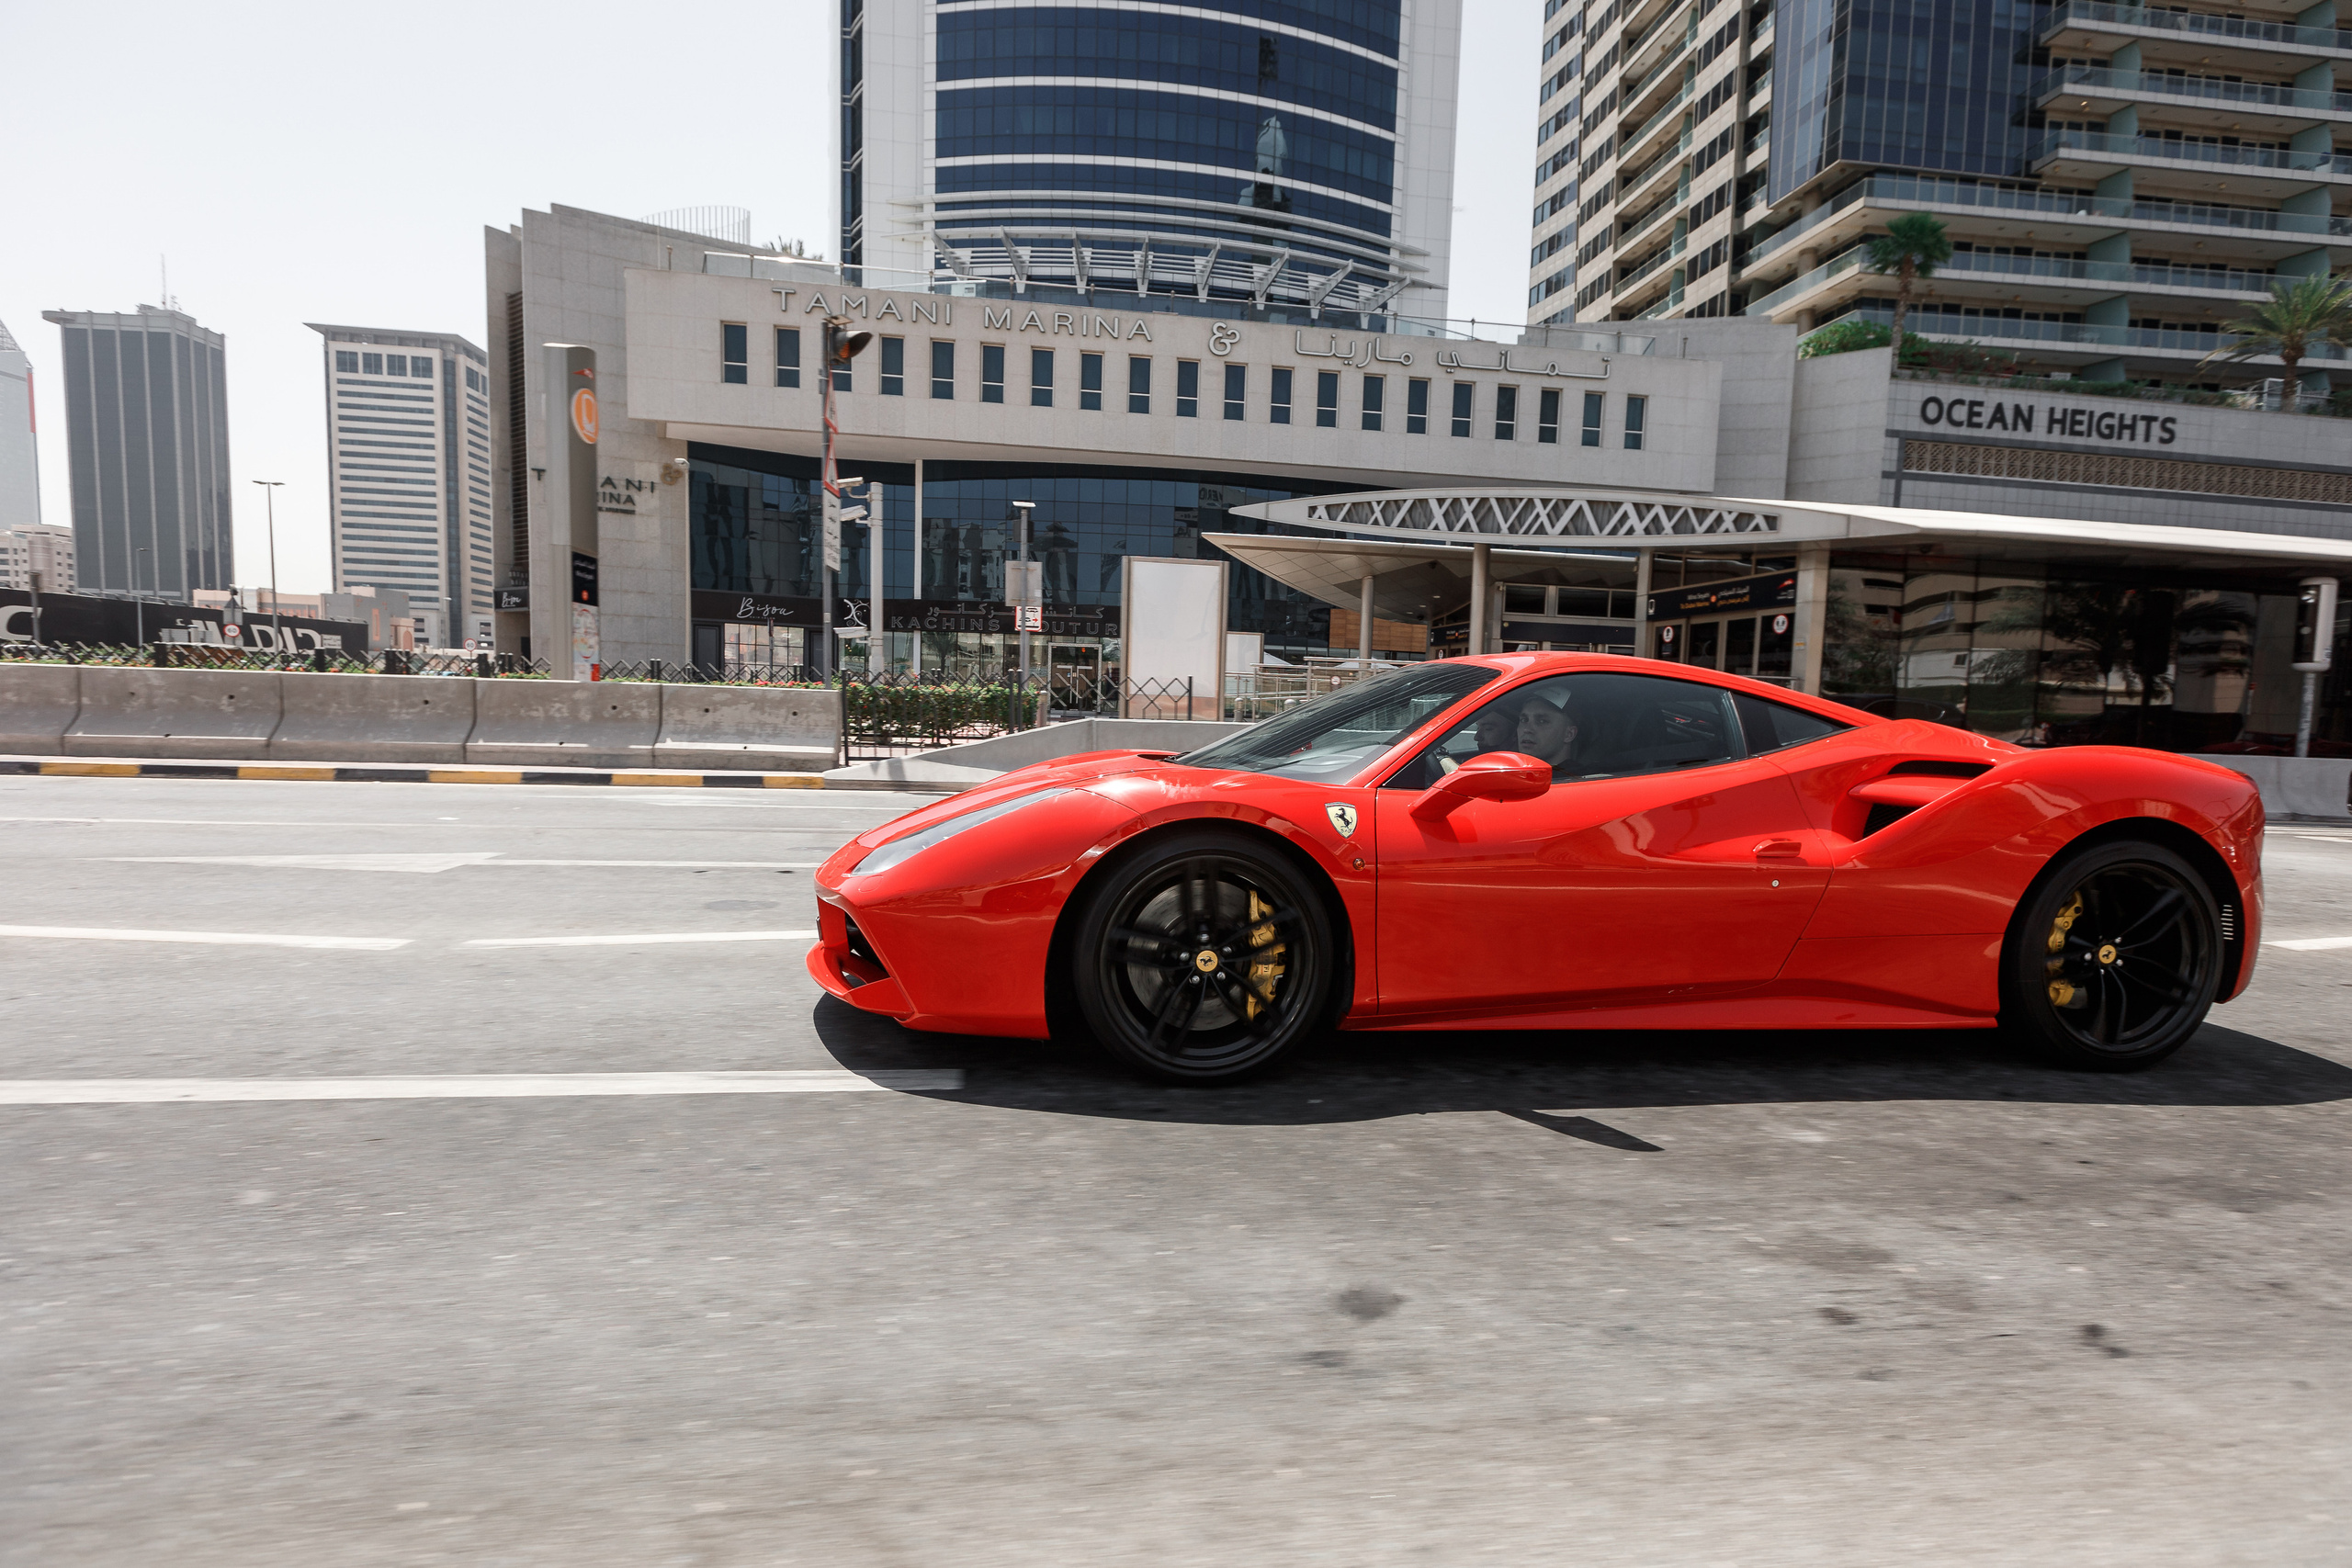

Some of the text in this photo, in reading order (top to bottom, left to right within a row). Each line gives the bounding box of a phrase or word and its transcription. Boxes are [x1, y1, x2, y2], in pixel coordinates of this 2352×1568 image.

[772, 288, 953, 325] TAMANI
[983, 305, 1154, 342] MARINA
[1295, 330, 1611, 379] تماني مارينا
[1920, 396, 2177, 445] OCEAN HEIGHTS
[891, 616, 1001, 632] KACHINS
